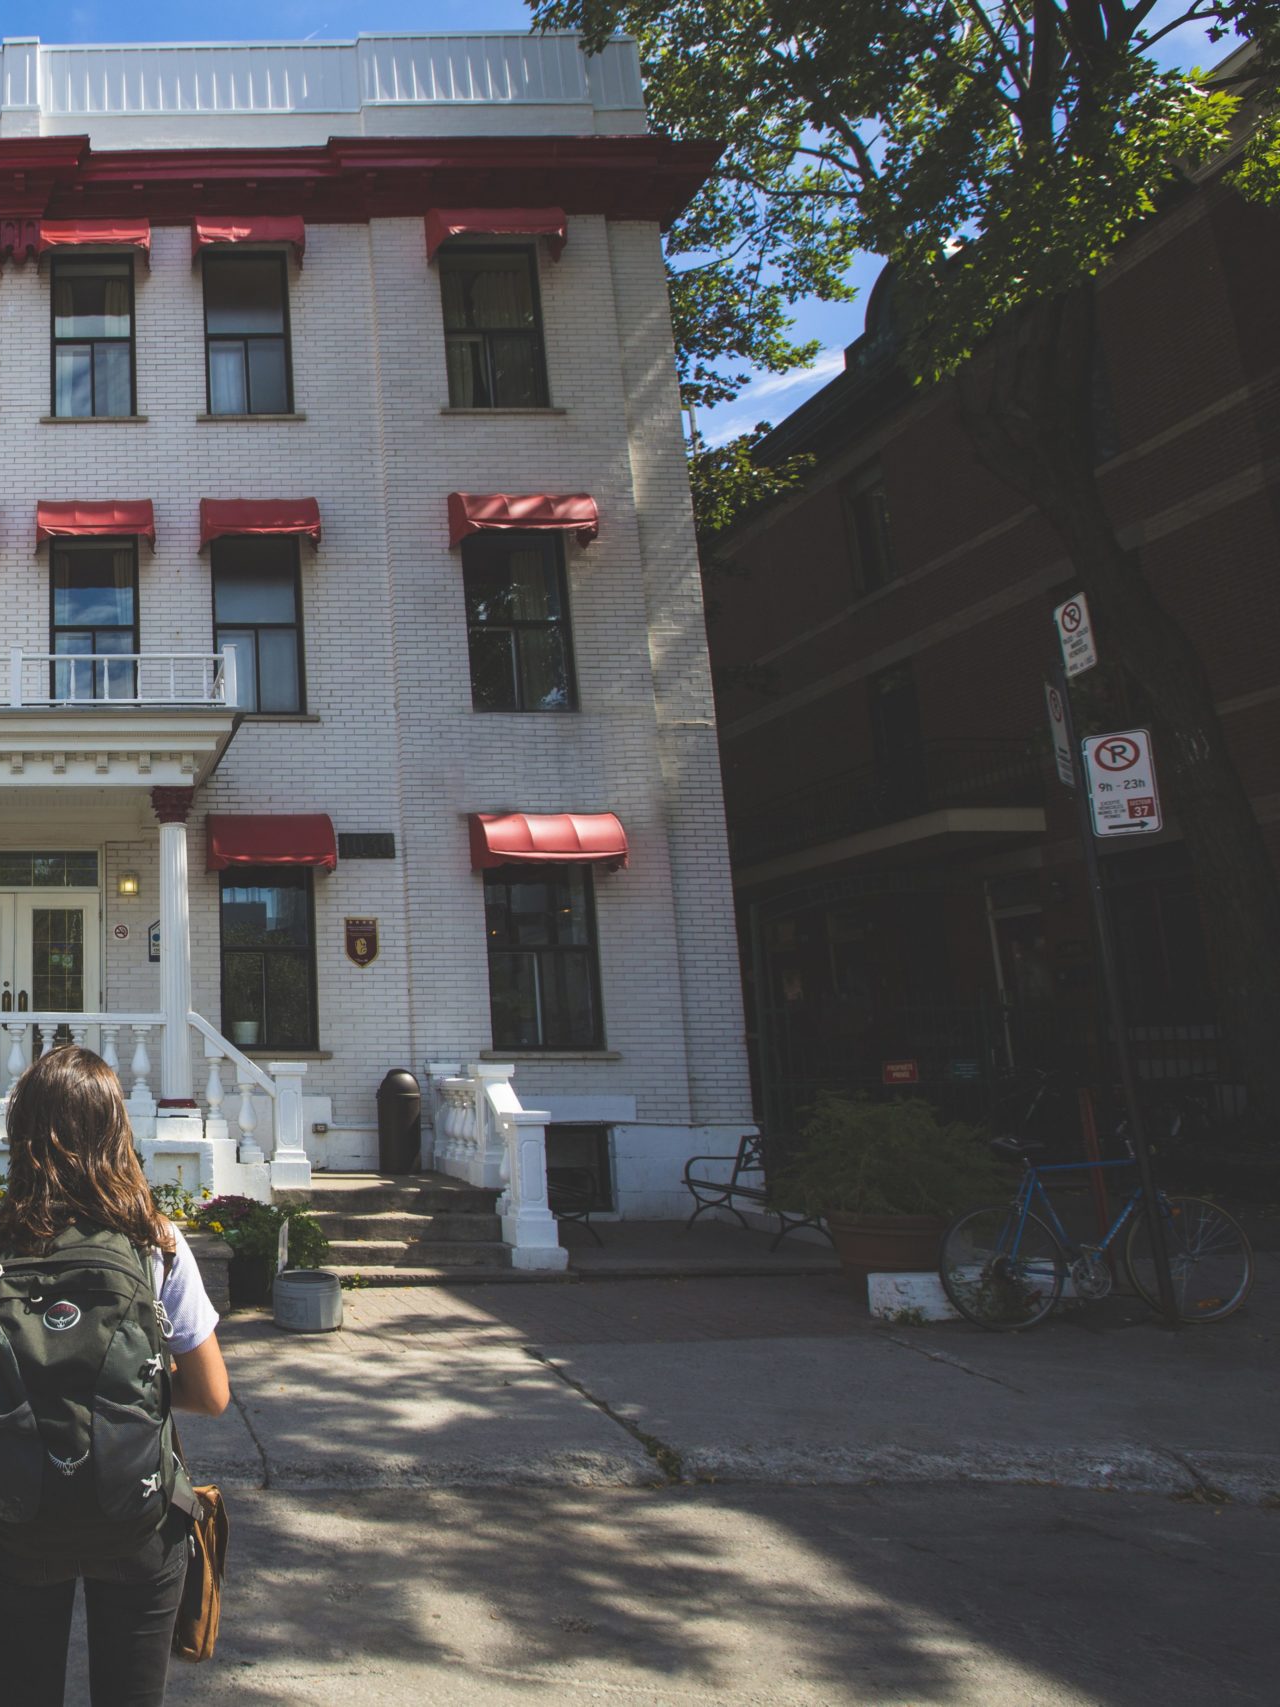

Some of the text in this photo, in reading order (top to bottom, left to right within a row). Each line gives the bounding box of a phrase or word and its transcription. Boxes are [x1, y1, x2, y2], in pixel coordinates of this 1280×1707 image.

[1098, 783, 1113, 792] 9h
[1123, 778, 1146, 790] 23h
[1134, 805, 1149, 817] 37
